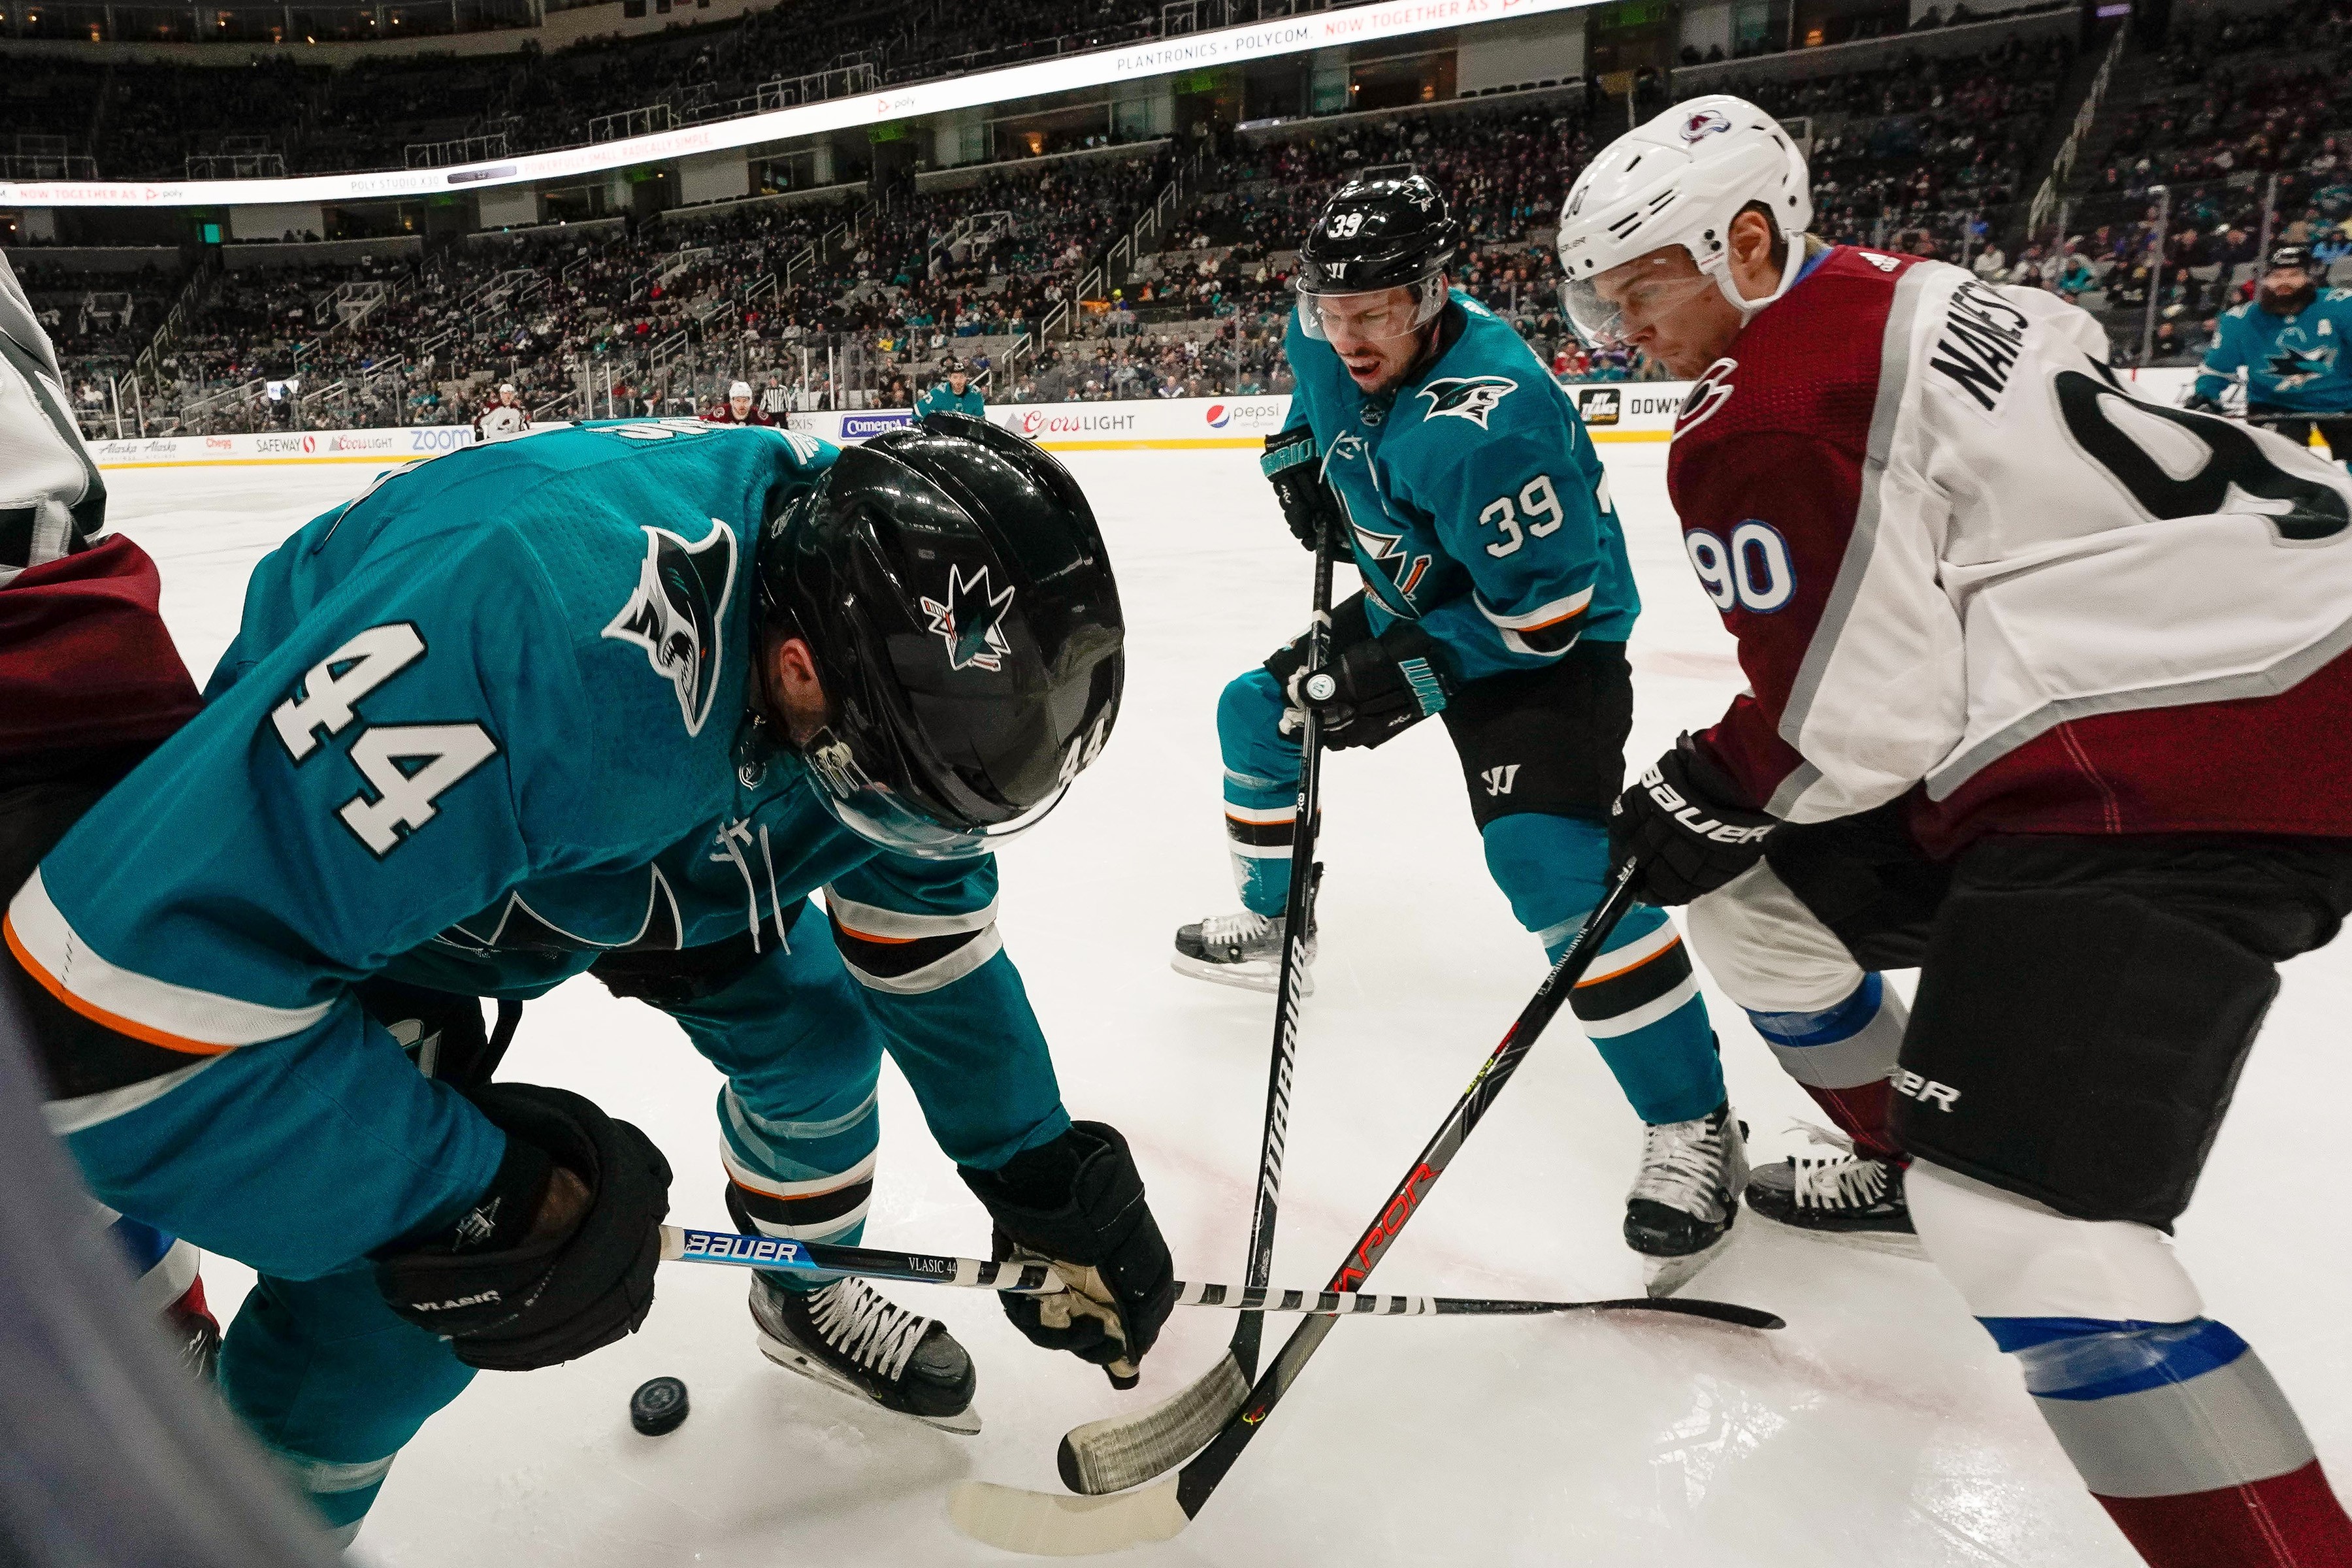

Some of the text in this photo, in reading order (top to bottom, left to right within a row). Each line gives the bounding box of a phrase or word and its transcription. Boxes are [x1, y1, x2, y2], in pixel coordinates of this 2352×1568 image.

[1117, 43, 1217, 71] PLANTRONICS
[1236, 26, 1313, 51] POLYCOM.
[1325, 18, 1364, 37] NOW
[1372, 3, 1459, 28] TOGETHER
[894, 96, 915, 110] poly
[525, 155, 584, 172] POWERFULLY
[623, 139, 672, 157] RADICALLY
[20, 189, 49, 199] NOW
[55, 189, 118, 199] TOGETHER
[122, 189, 137, 199] AS
[351, 180, 375, 190] POLY
[380, 178, 416, 189] STUDIO
[1327, 212, 1364, 238] 39
[1929, 278, 2029, 412] NAMES
[1024, 410, 1135, 432] Cors LIGHT
[1233, 402, 1279, 420] pepsi
[257, 438, 301, 453] SAFEWAY
[368, 437, 392, 449] LIGHT
[411, 429, 472, 450] zoom
[1478, 474, 1564, 559] 39
[1685, 519, 1796, 612] 90
[270, 621, 500, 858] 44
[1057, 717, 1106, 787] 44
[1264, 936, 1306, 1207] WARRIOR
[687, 1234, 798, 1264] BAUER
[908, 1256, 957, 1275] VLASIC 44
[412, 1290, 502, 1312] VLASIC
